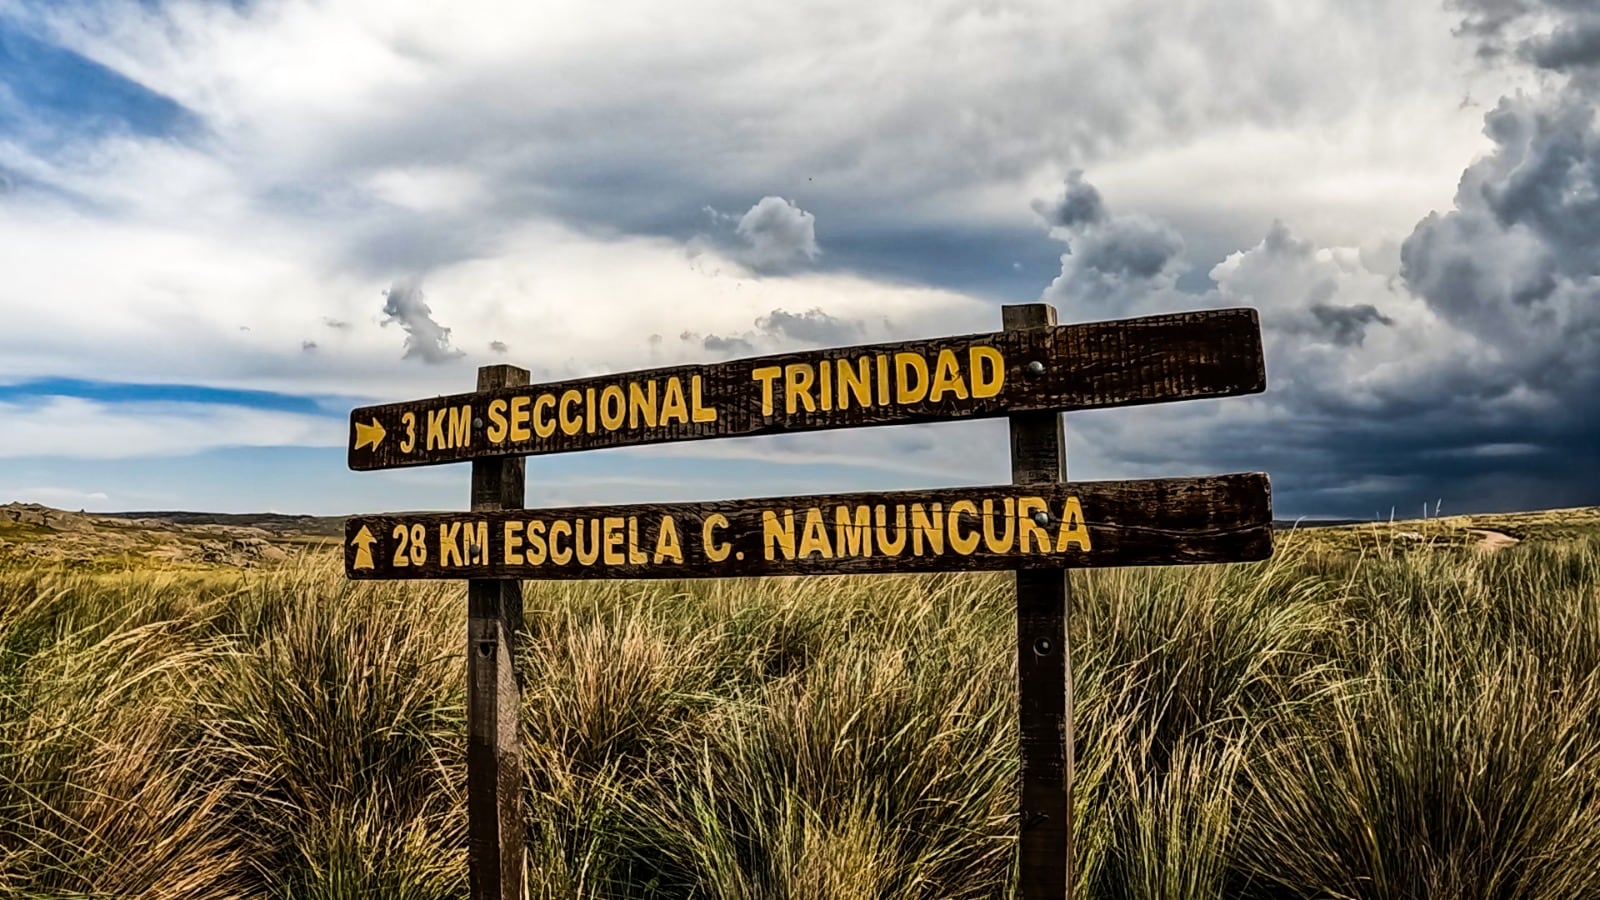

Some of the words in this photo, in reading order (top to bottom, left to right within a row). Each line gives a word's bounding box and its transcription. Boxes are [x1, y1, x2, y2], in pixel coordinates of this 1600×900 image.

[400, 411, 416, 453] 3
[426, 404, 472, 451] KM
[486, 374, 718, 444] SECCIONAL
[751, 346, 1005, 417] TRINIDAD
[392, 523, 427, 567] 28
[439, 521, 489, 567] KM
[504, 515, 684, 566] ESCUELA
[702, 512, 745, 563] C.
[762, 496, 1092, 561] NAMUNCURA
